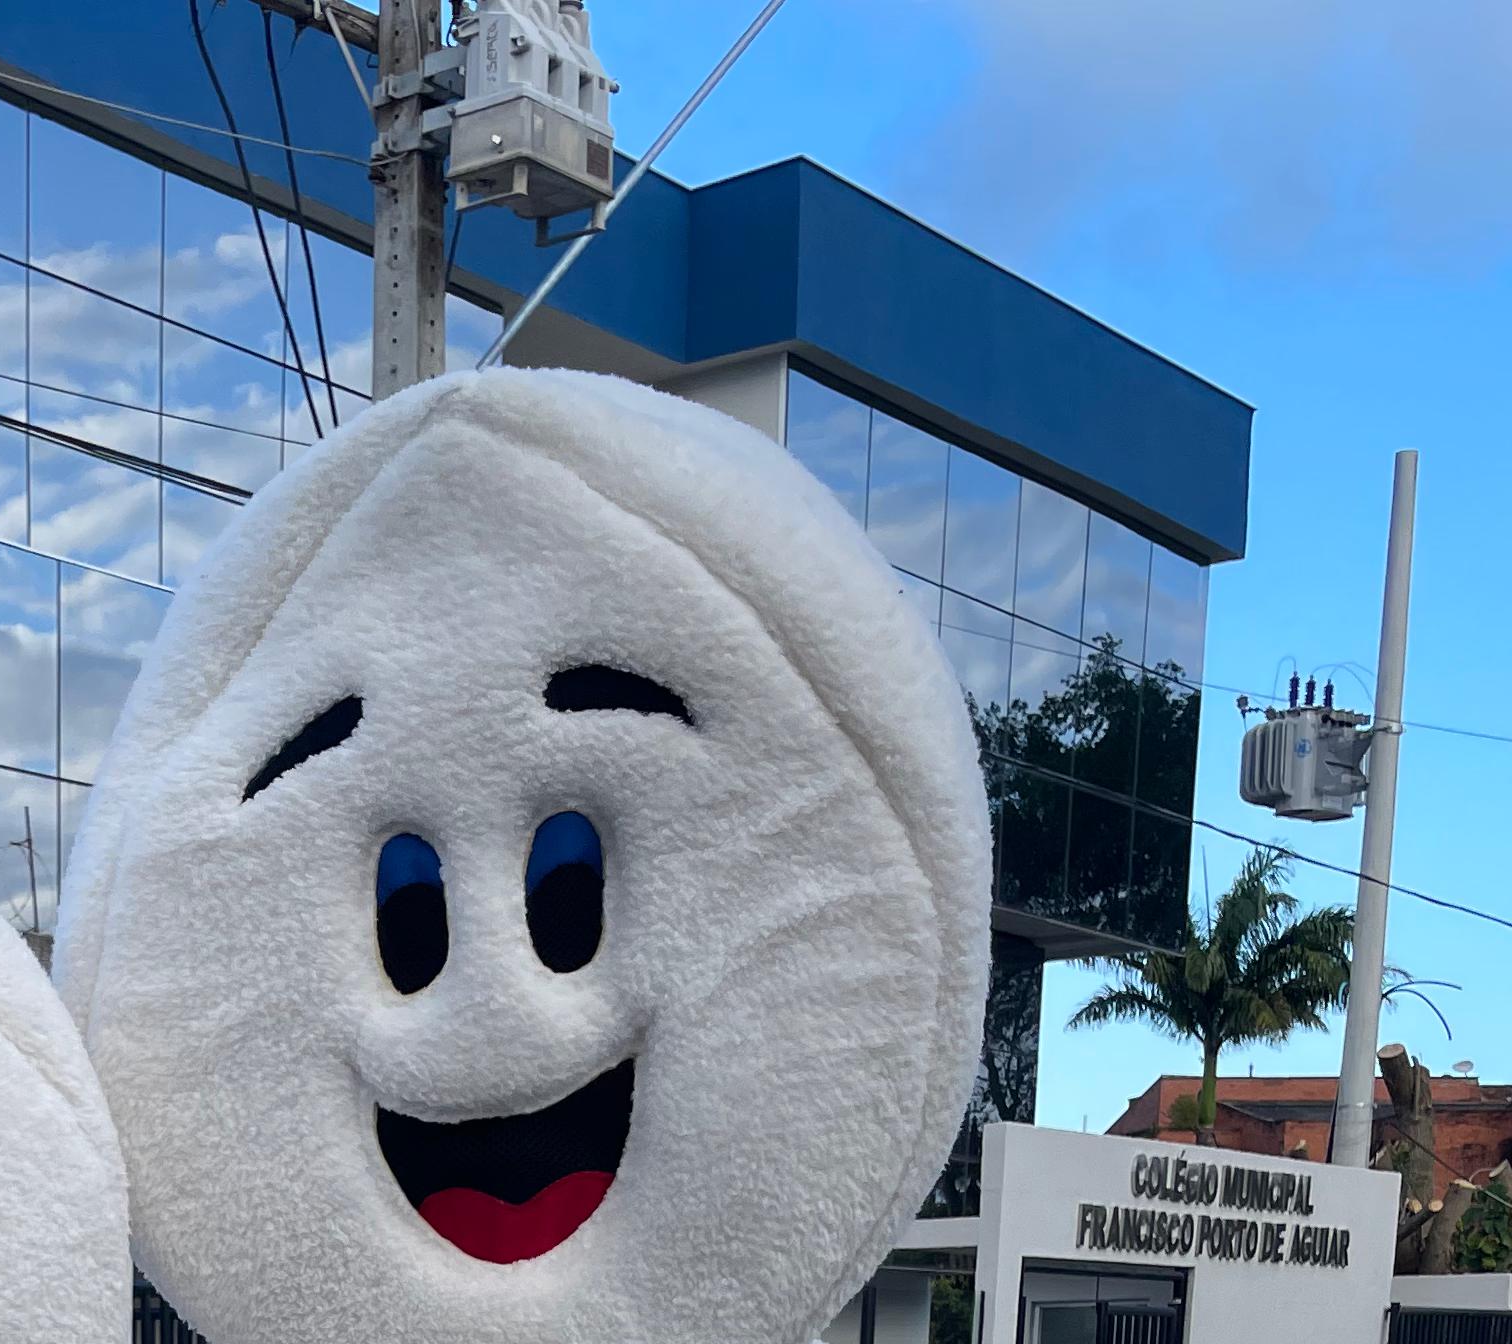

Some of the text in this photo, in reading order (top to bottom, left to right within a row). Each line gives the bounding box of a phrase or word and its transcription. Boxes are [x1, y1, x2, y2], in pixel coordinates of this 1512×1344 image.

[1131, 1151, 1314, 1216] COLÉGIO MUNICIPAL
[1076, 1203, 1350, 1268] FRANCISCO PORTO DE AGUIAR
